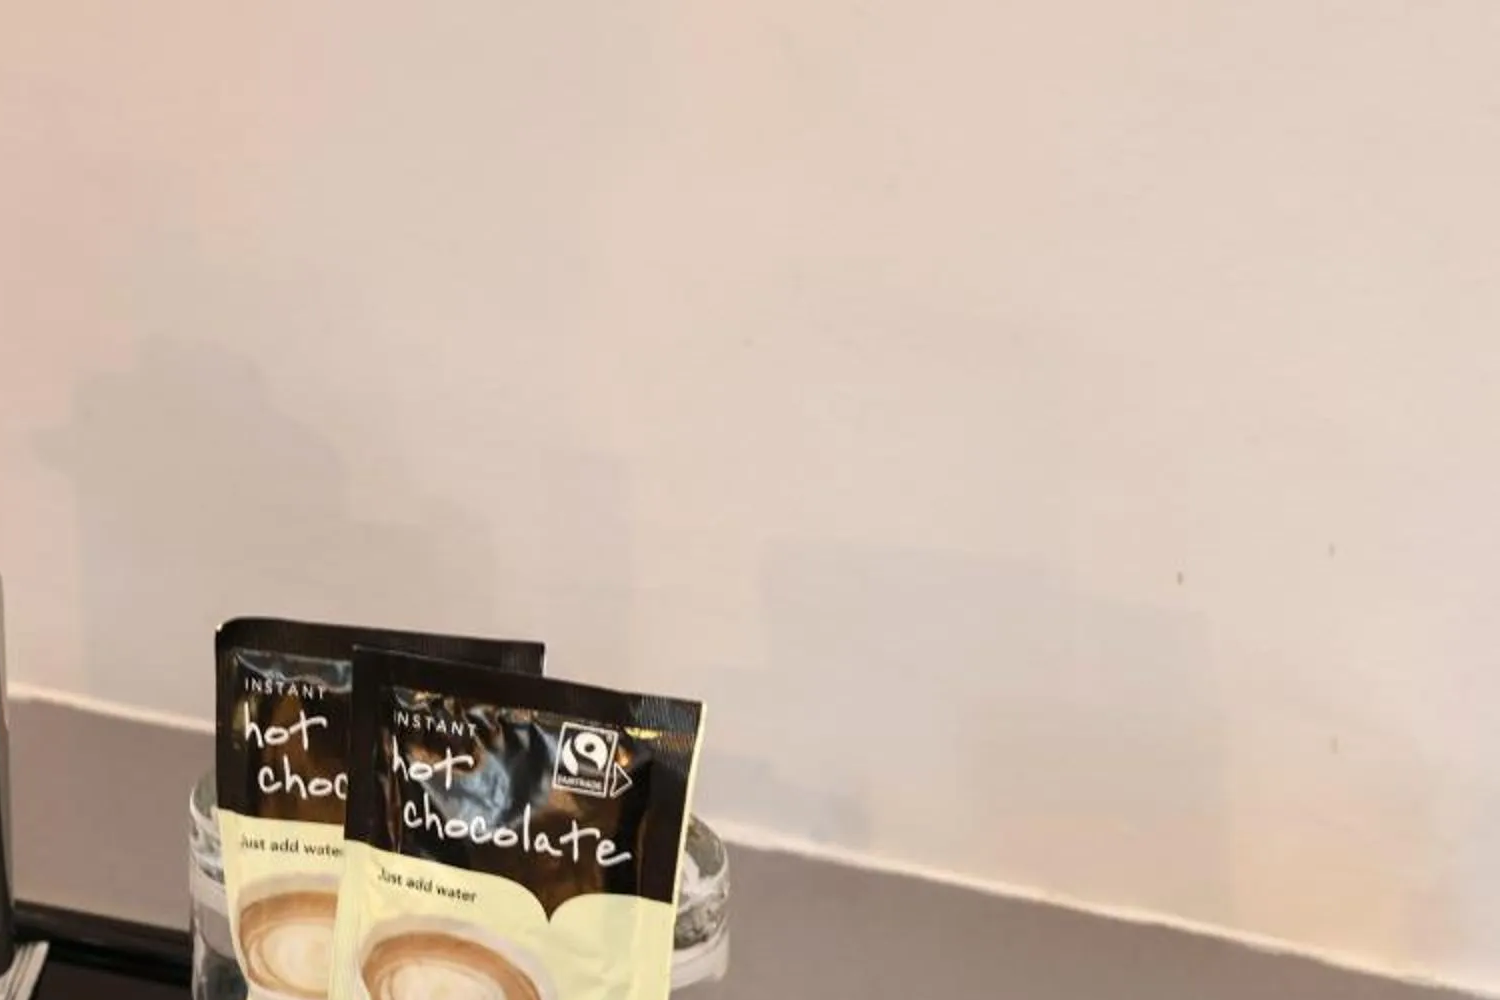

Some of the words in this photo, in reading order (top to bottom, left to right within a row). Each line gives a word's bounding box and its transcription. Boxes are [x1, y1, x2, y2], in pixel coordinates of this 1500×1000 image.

[244, 677, 326, 699] INSTANT
[243, 700, 328, 751] hot
[393, 710, 478, 738] INSTANT
[391, 734, 476, 791] hot
[240, 833, 266, 850] Just
[269, 838, 300, 853] add
[303, 843, 344, 857] wate
[403, 793, 632, 867] chocolate
[377, 866, 403, 886] Just
[405, 873, 434, 893] add
[435, 884, 478, 904] water
